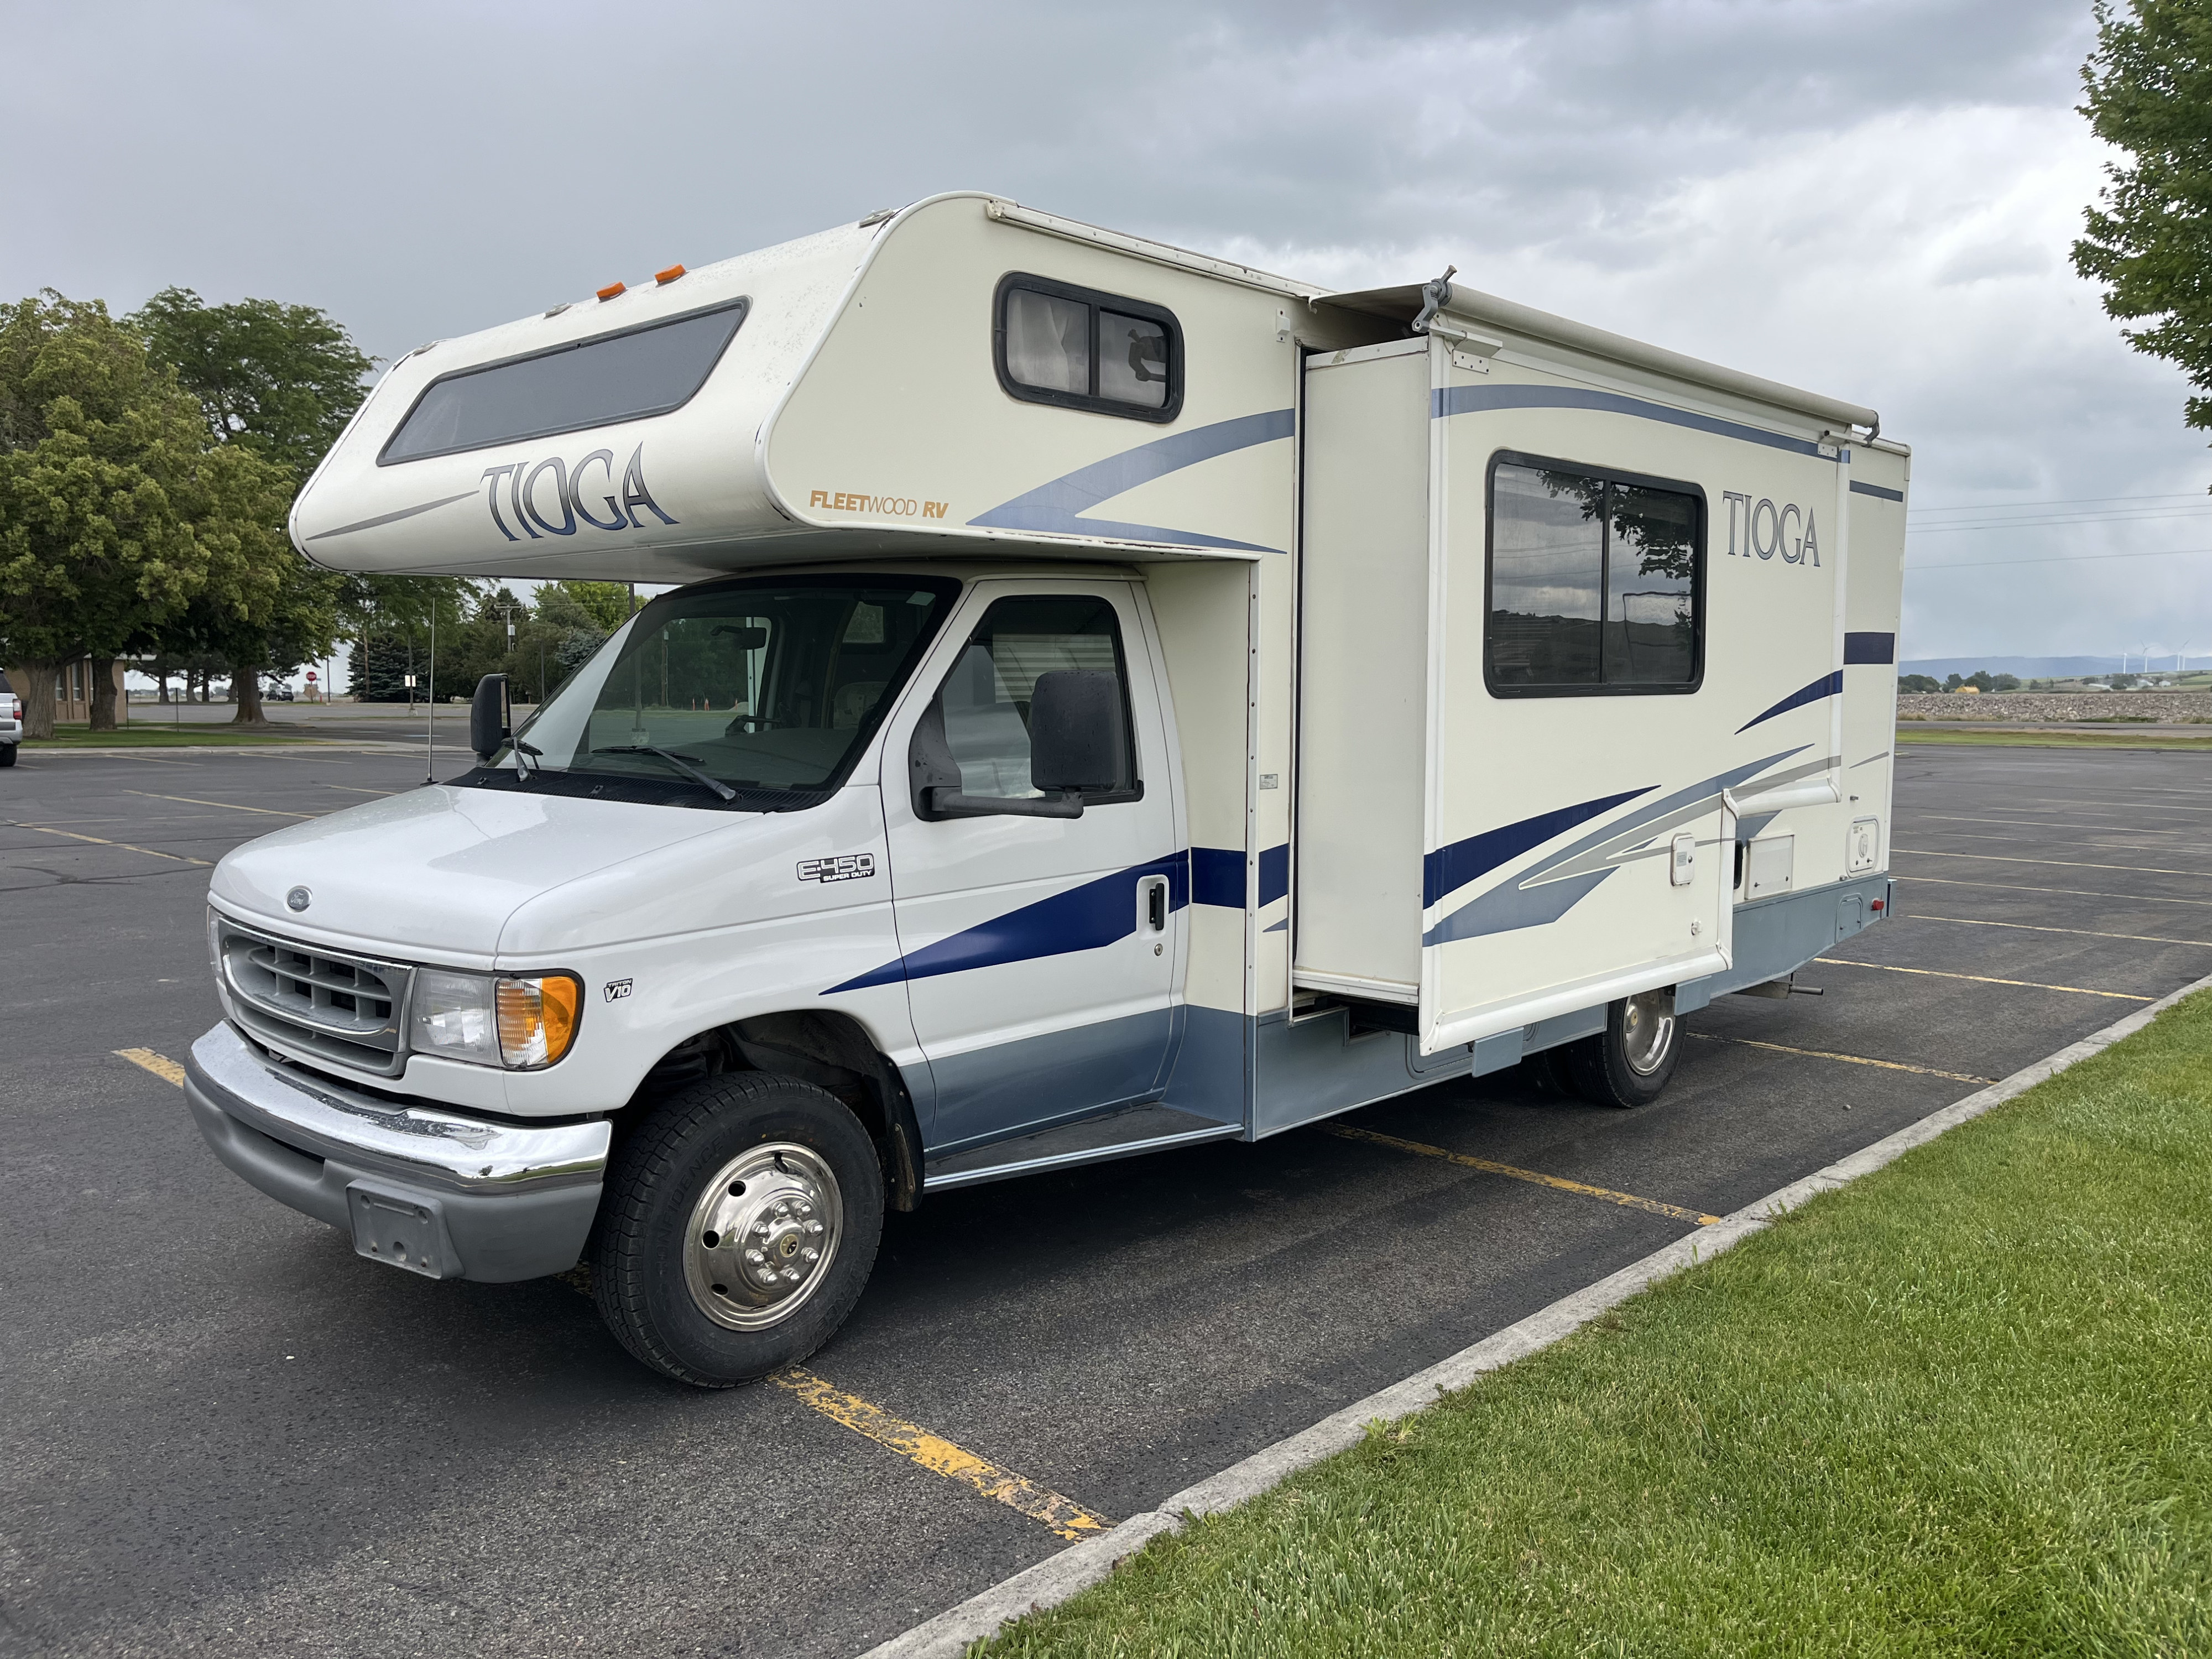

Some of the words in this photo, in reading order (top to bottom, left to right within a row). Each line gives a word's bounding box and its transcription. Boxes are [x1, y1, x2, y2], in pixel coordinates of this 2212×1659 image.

[480, 440, 680, 541] TIOGA
[810, 490, 917, 515] FLEETWOOD
[922, 501, 949, 518] RV
[1723, 491, 1820, 567] TIOGA
[823, 873, 849, 881] SUPER
[290, 891, 305, 905] Ford
[608, 979, 632, 988] TRITON
[604, 984, 631, 1001] V10
